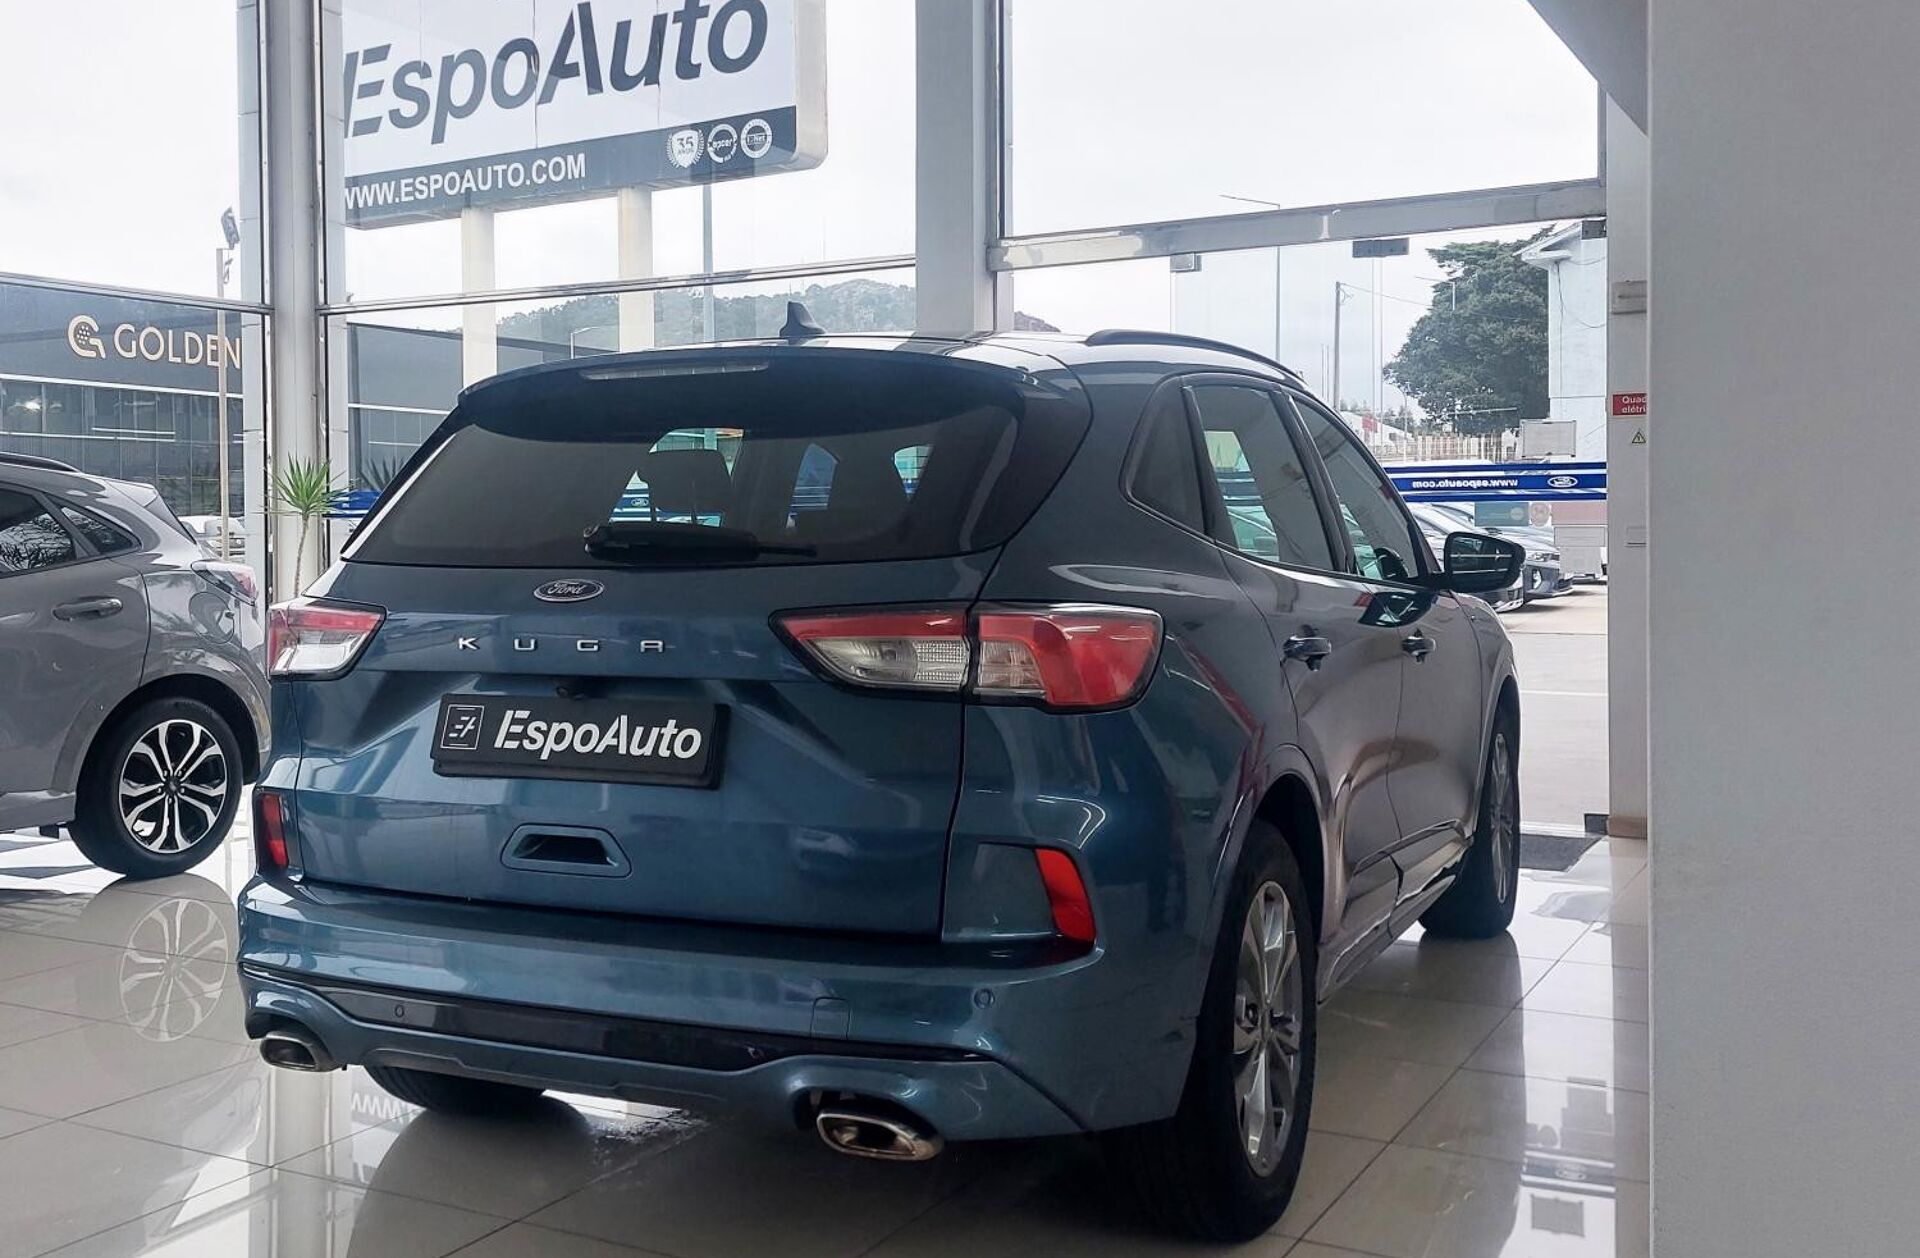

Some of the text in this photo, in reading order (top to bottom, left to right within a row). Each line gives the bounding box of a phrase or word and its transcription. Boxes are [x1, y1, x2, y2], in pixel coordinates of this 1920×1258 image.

[344, 0, 768, 145] EspoAuto
[114, 323, 242, 370] GOLDEN
[458, 636, 665, 653] KUGA
[493, 709, 702, 760] EspoAuto
